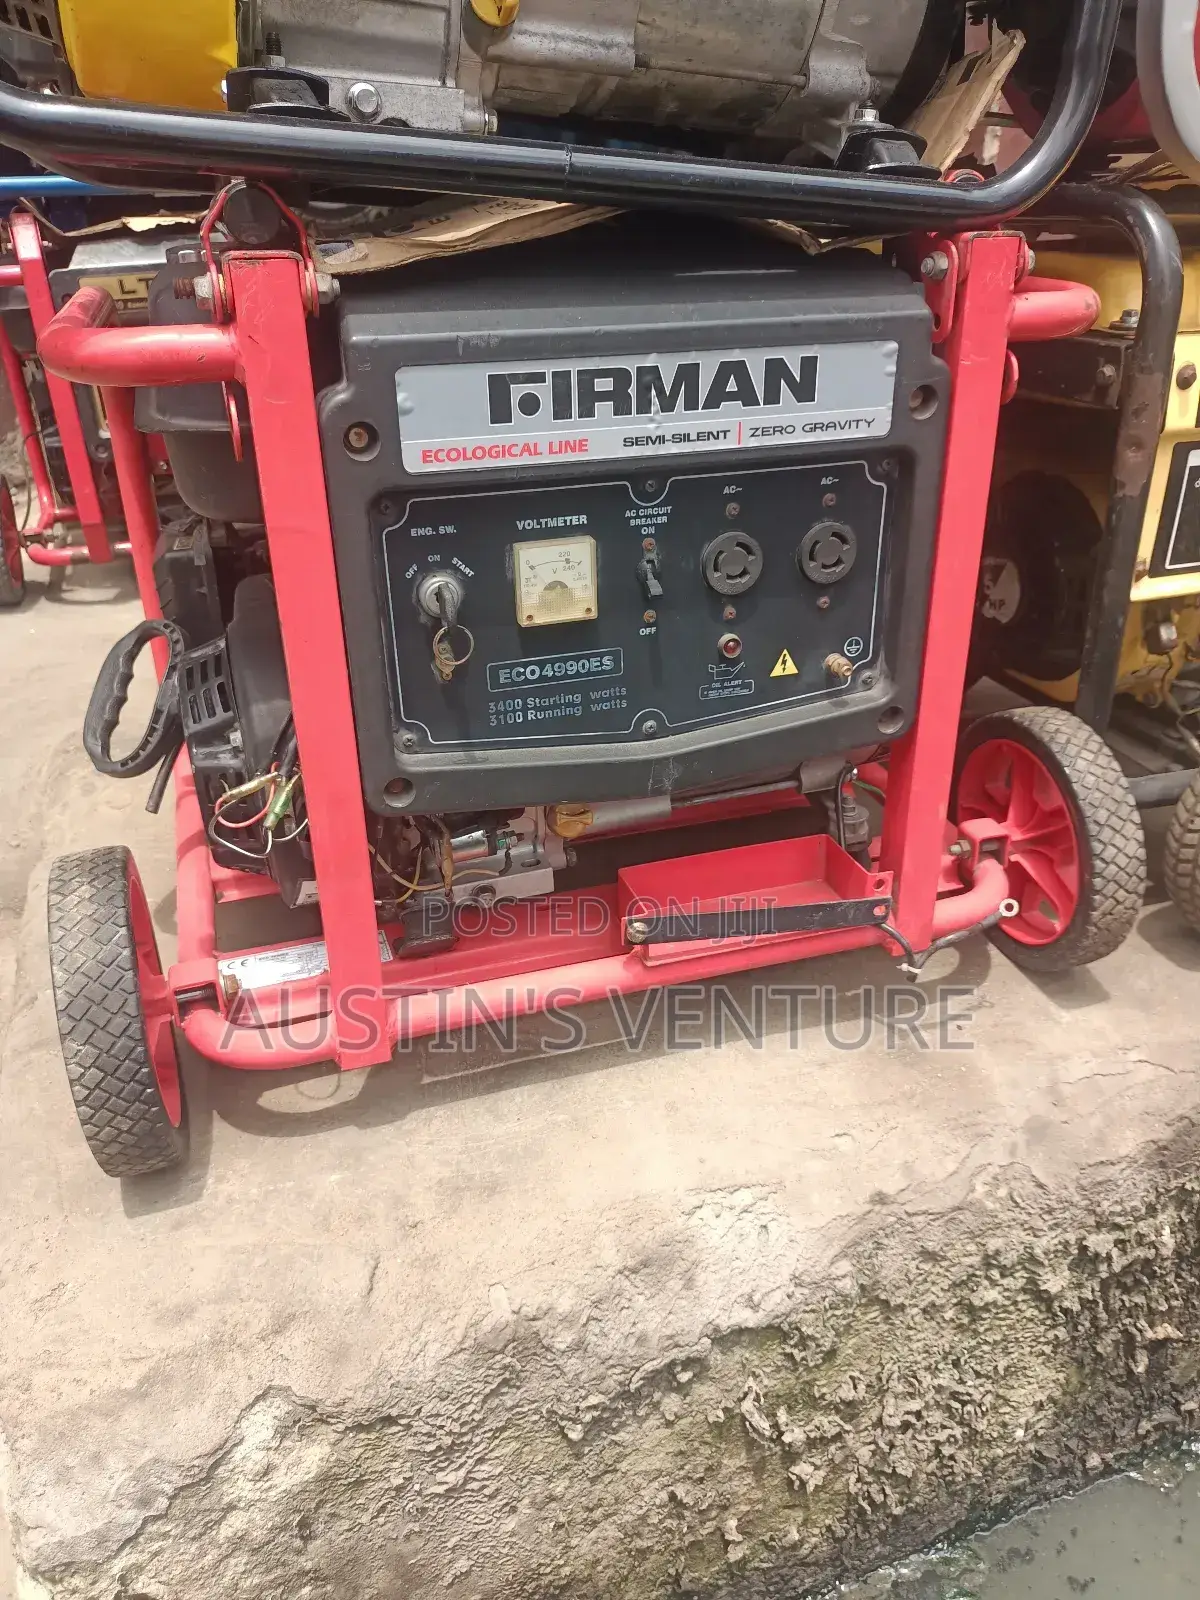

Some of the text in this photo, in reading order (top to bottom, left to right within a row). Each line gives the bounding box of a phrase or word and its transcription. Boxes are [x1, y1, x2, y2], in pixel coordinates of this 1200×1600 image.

[487, 355, 820, 427] FIRMAN
[749, 417, 875, 438] ZERO GRAVITY
[622, 429, 731, 448] SEMI-SILENT
[421, 438, 589, 464] ECOLOGICAL LINE
[625, 506, 672, 518] AC CIRCUIT
[630, 516, 667, 526] BREAKER
[410, 525, 457, 537] ENG. SW.
[516, 514, 588, 531] VOLTMETER
[641, 526, 655, 534] ON
[428, 554, 441, 562] ON
[451, 557, 475, 577] START
[405, 563, 418, 579] OFF
[639, 627, 656, 636] OFF
[499, 655, 615, 683] ECO4990ES
[489, 686, 627, 713] 3400 Starting watts
[489, 699, 627, 726] 3100 Running watts
